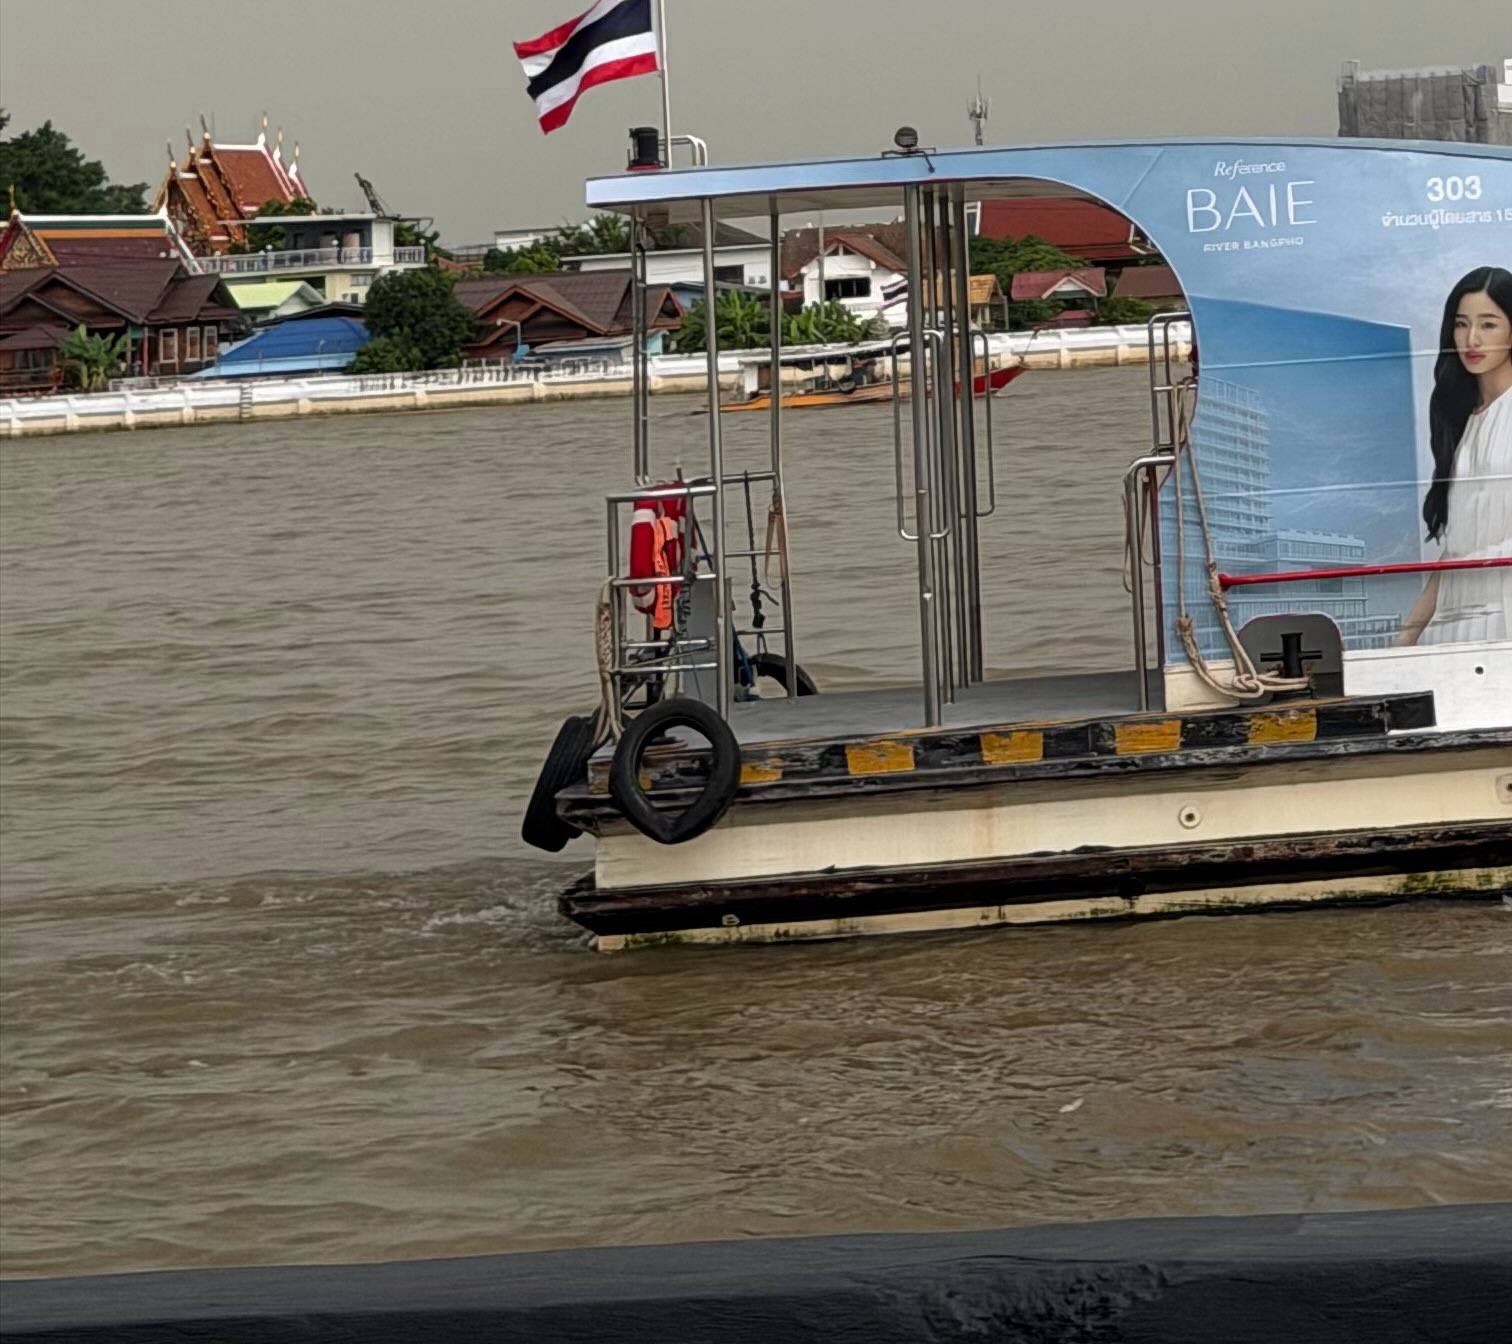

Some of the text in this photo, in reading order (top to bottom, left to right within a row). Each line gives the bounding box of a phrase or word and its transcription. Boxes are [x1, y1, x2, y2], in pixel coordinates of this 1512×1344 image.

[1214, 159, 1287, 180] Reference
[1426, 176, 1482, 202] 303
[1187, 180, 1318, 233] BAIE
[1203, 241, 1240, 252] RIVER
